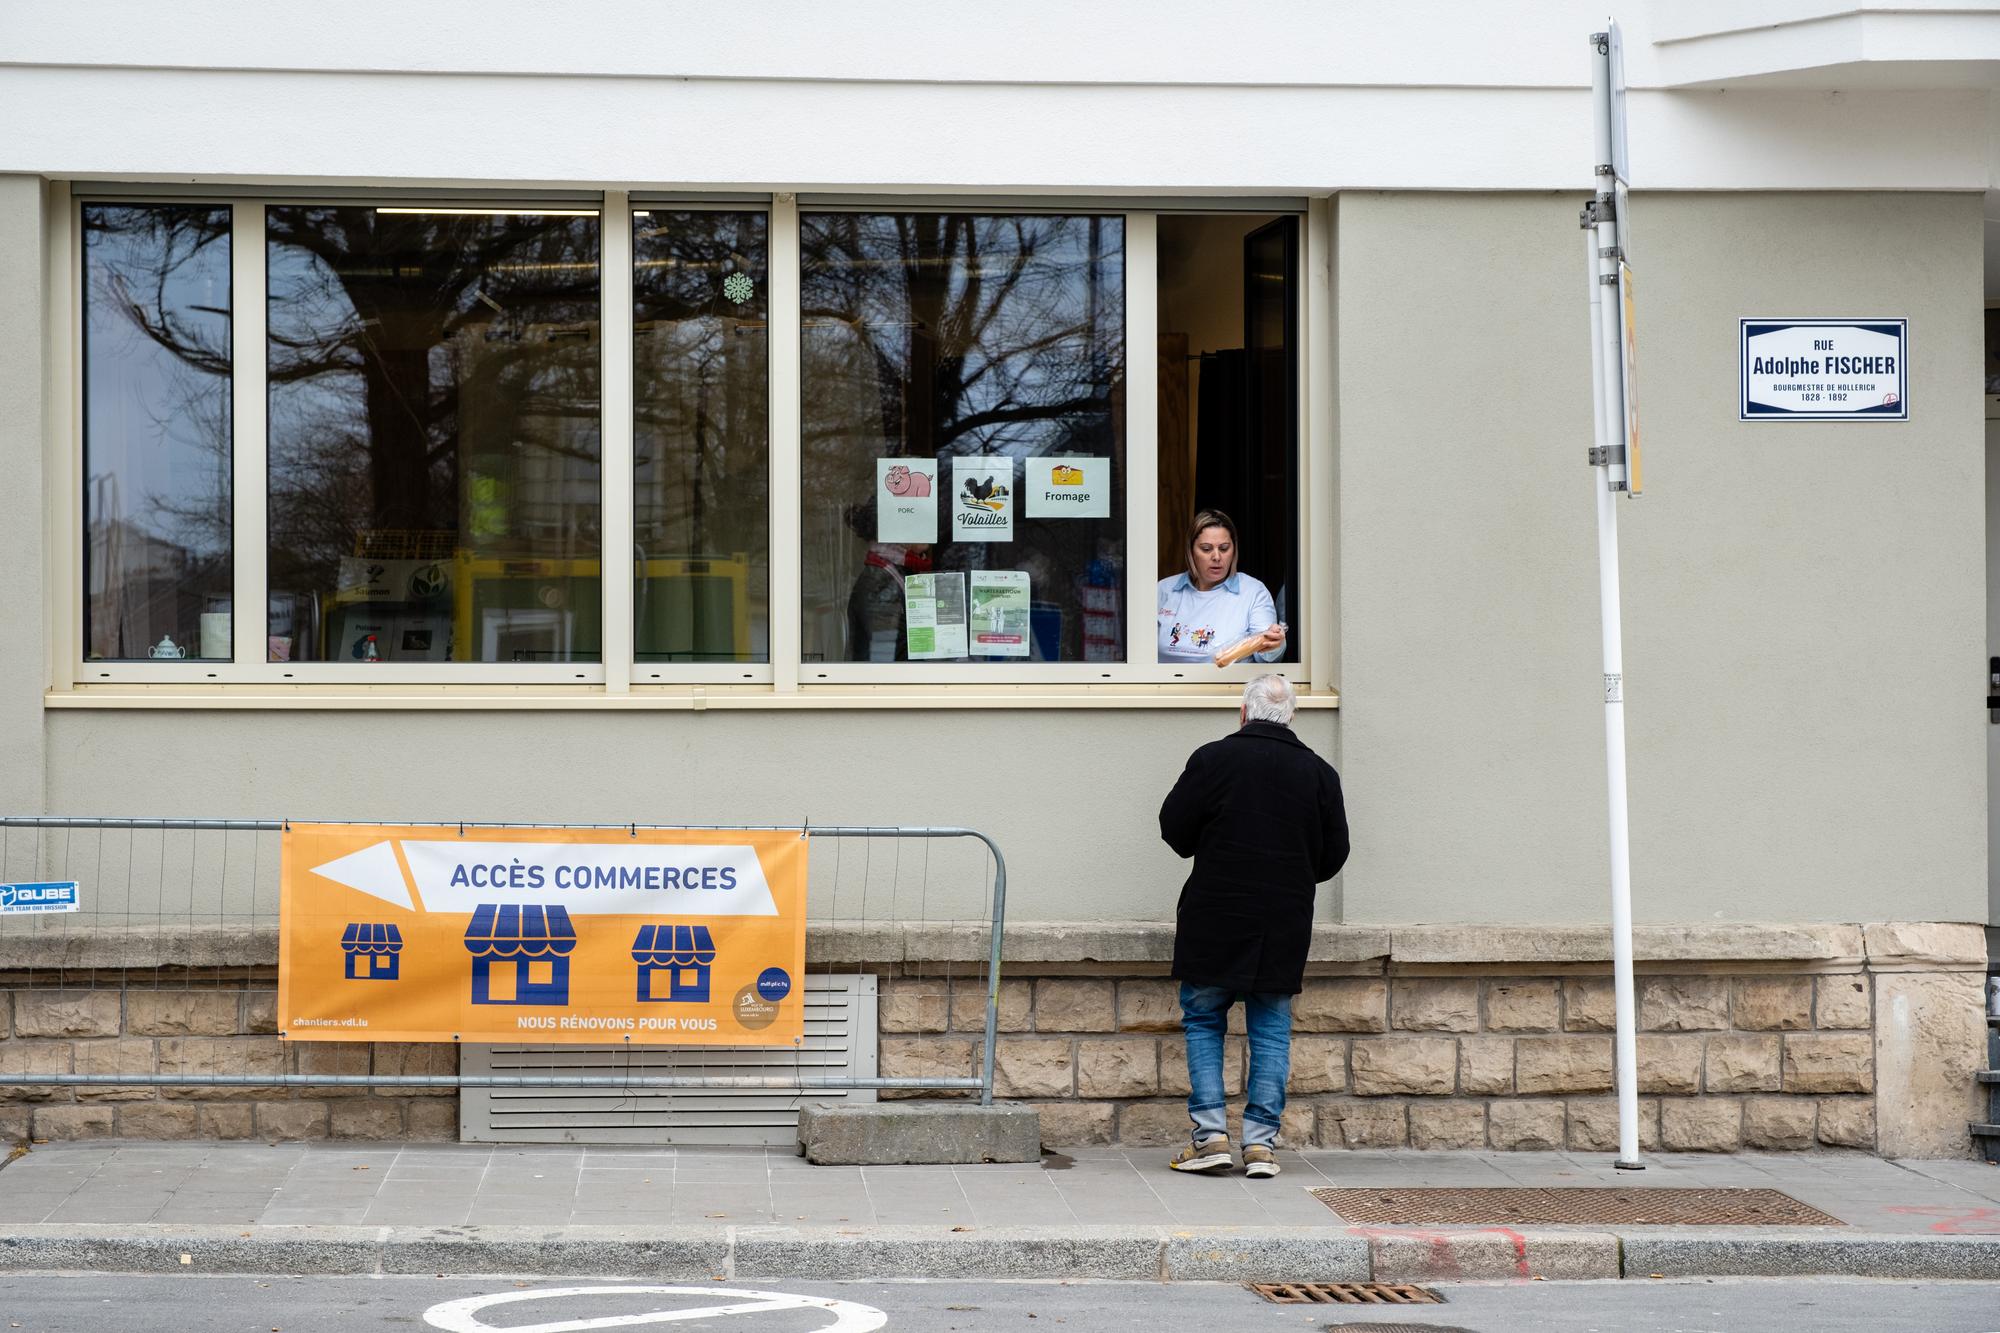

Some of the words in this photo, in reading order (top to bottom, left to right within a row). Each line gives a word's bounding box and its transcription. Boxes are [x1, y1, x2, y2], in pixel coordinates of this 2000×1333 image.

[1814, 340, 1834, 351] RUE
[1753, 356, 1820, 377] Adolphe
[1825, 356, 1896, 375] FISCHER
[1773, 384, 1824, 392] BOURGMESTRE
[1826, 384, 1836, 392] DE
[1837, 384, 1876, 392] HOLLERICH
[1801, 393, 1821, 402] 1828
[1828, 393, 1848, 402] 1892
[1045, 491, 1091, 503] Fromage
[957, 512, 1009, 527] Volailles
[450, 858, 545, 890] ACCÈS
[554, 866, 737, 891] COMMERCES
[17, 888, 71, 900] QUBE
[293, 1017, 369, 1027] chantiers.vdl.lu
[518, 1017, 557, 1029] NOUS
[560, 1014, 636, 1030] RÉNOVONS
[639, 1017, 676, 1030] POUR
[679, 1018, 718, 1031] VOUS
